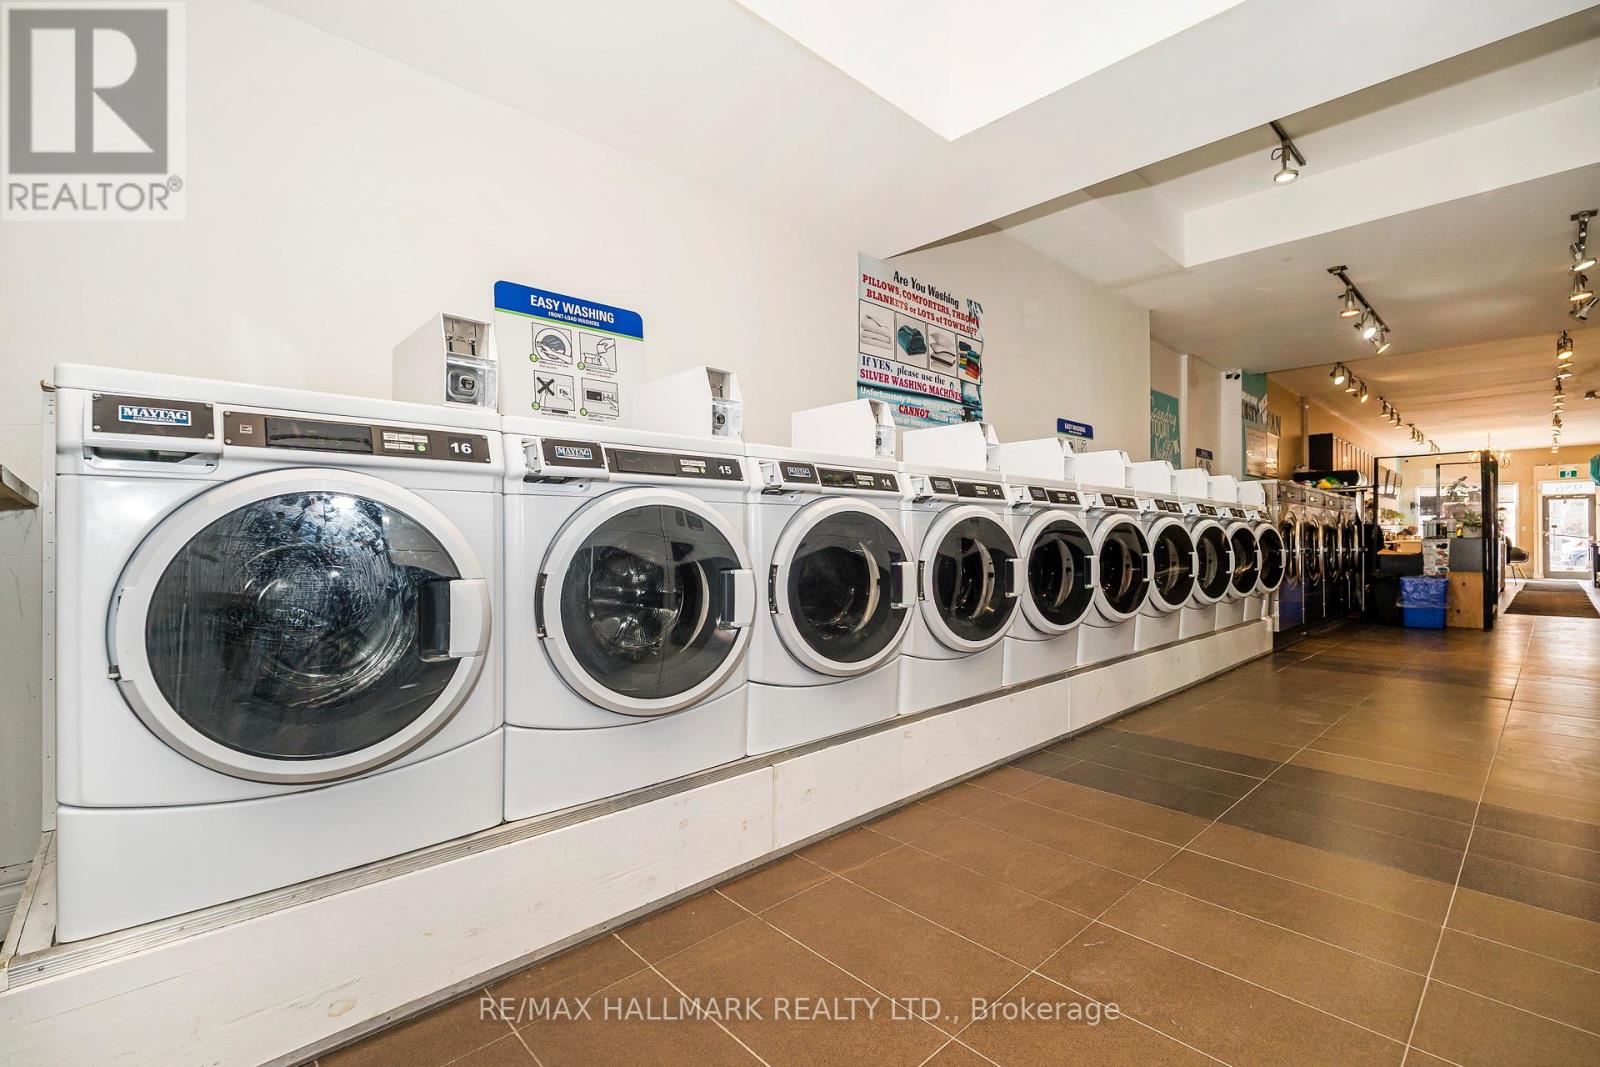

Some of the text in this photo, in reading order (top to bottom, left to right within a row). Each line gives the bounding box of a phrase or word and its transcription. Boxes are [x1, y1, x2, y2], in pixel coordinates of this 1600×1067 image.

[862, 273, 902, 298] PILLOWS,
[902, 289, 951, 317] COMFORTERS,
[893, 271, 959, 309] Are You Washing
[530, 294, 615, 324] EASY WASHING
[867, 288, 908, 310] BLANKETS
[917, 306, 935, 321] LOTS
[862, 356, 871, 367] If
[897, 366, 920, 379] please
[921, 373, 933, 382] use
[934, 374, 946, 385] the
[860, 368, 963, 403] SILVER WASHING MACHINES
[122, 407, 188, 420] MAYTAG
[898, 405, 930, 419] CANNOT
[450, 442, 473, 454] 16
[556, 446, 592, 457] MAYTAG
[718, 465, 732, 475] 15
[882, 478, 892, 487] 14
